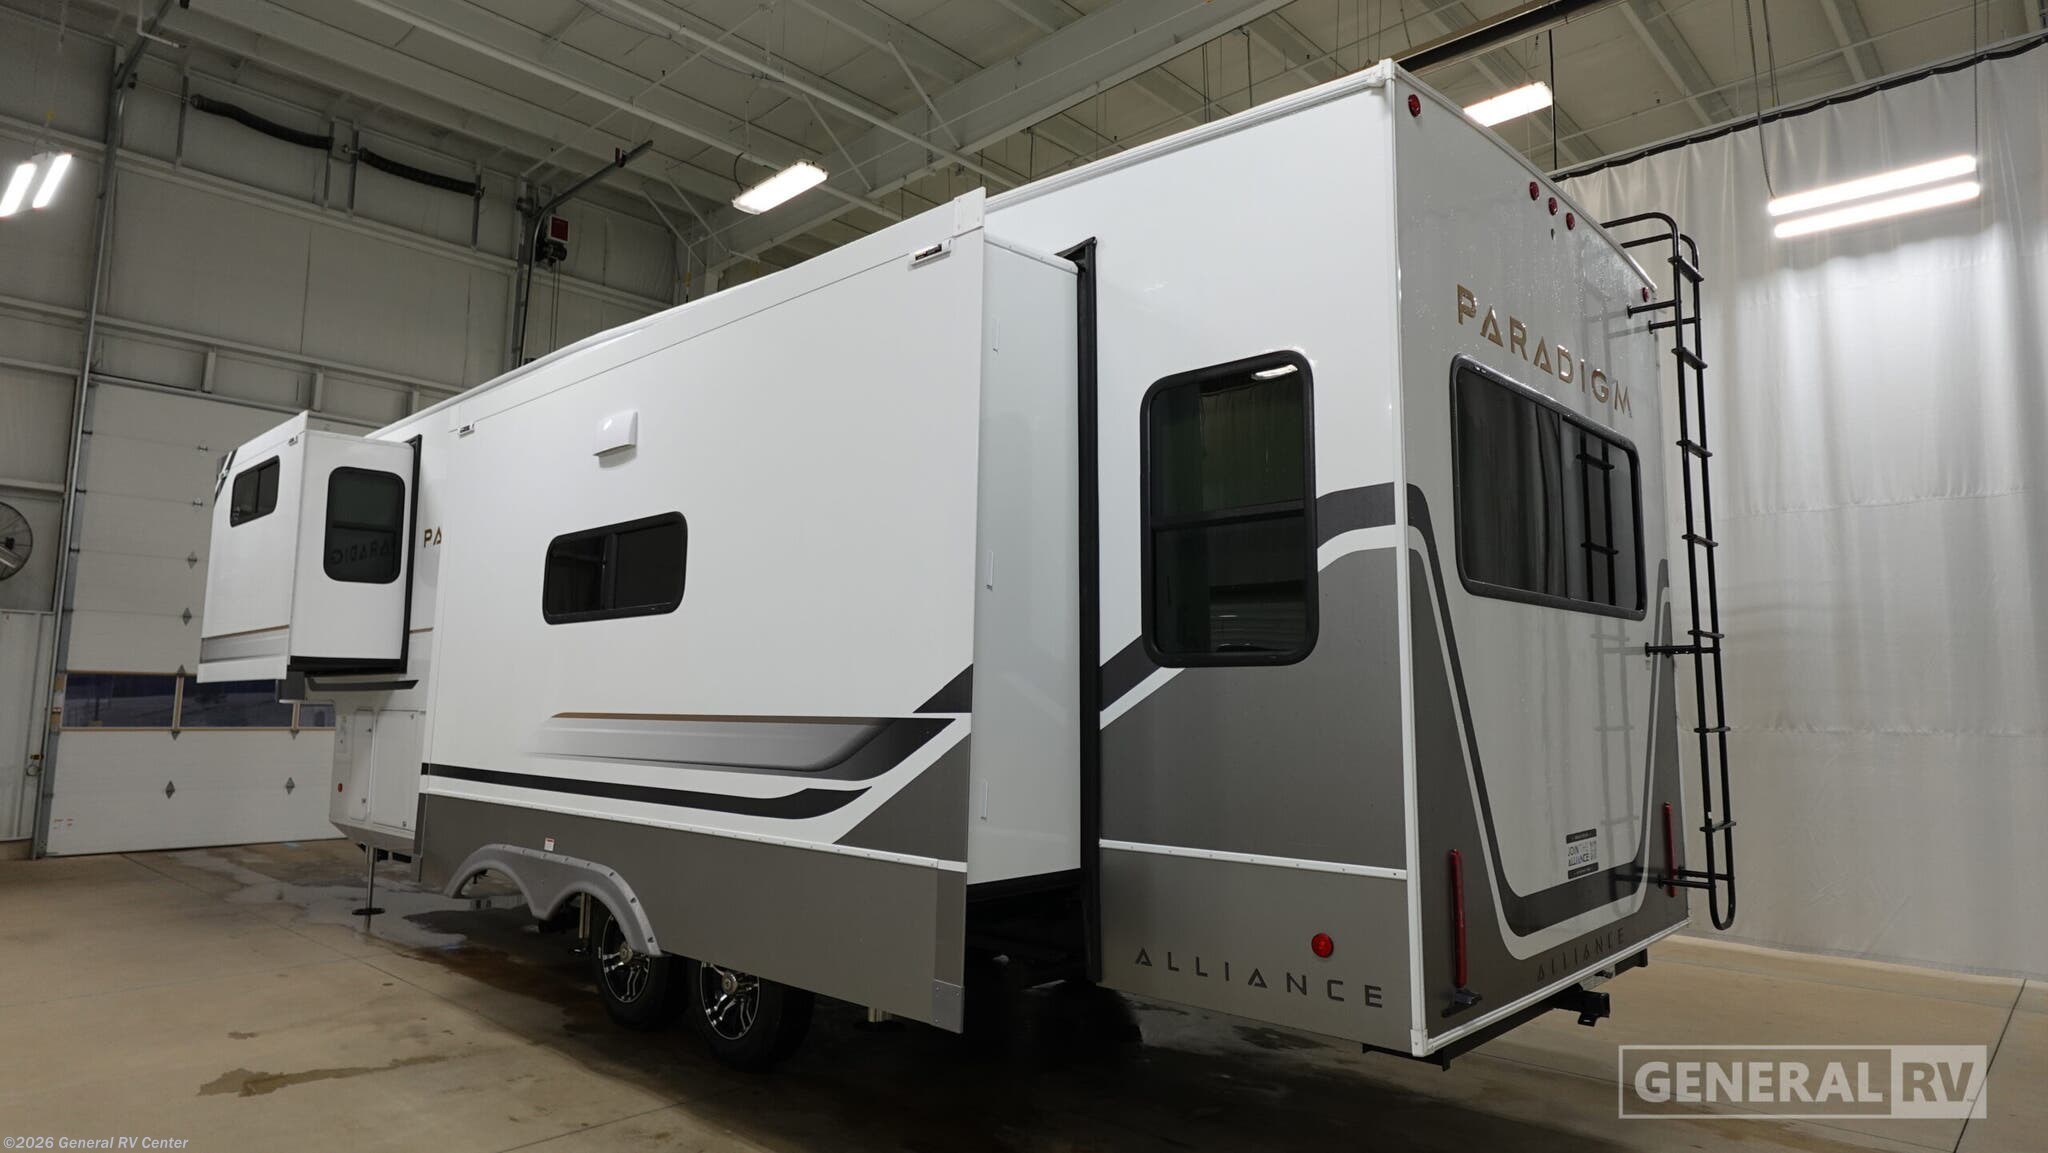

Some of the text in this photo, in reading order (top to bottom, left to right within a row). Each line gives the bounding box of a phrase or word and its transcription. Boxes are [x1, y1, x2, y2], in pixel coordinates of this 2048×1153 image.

[1457, 284, 1632, 418] PARADIGM
[1135, 947, 1383, 1009] ALLIANCE
[1537, 927, 1625, 982] ALLIANCE
